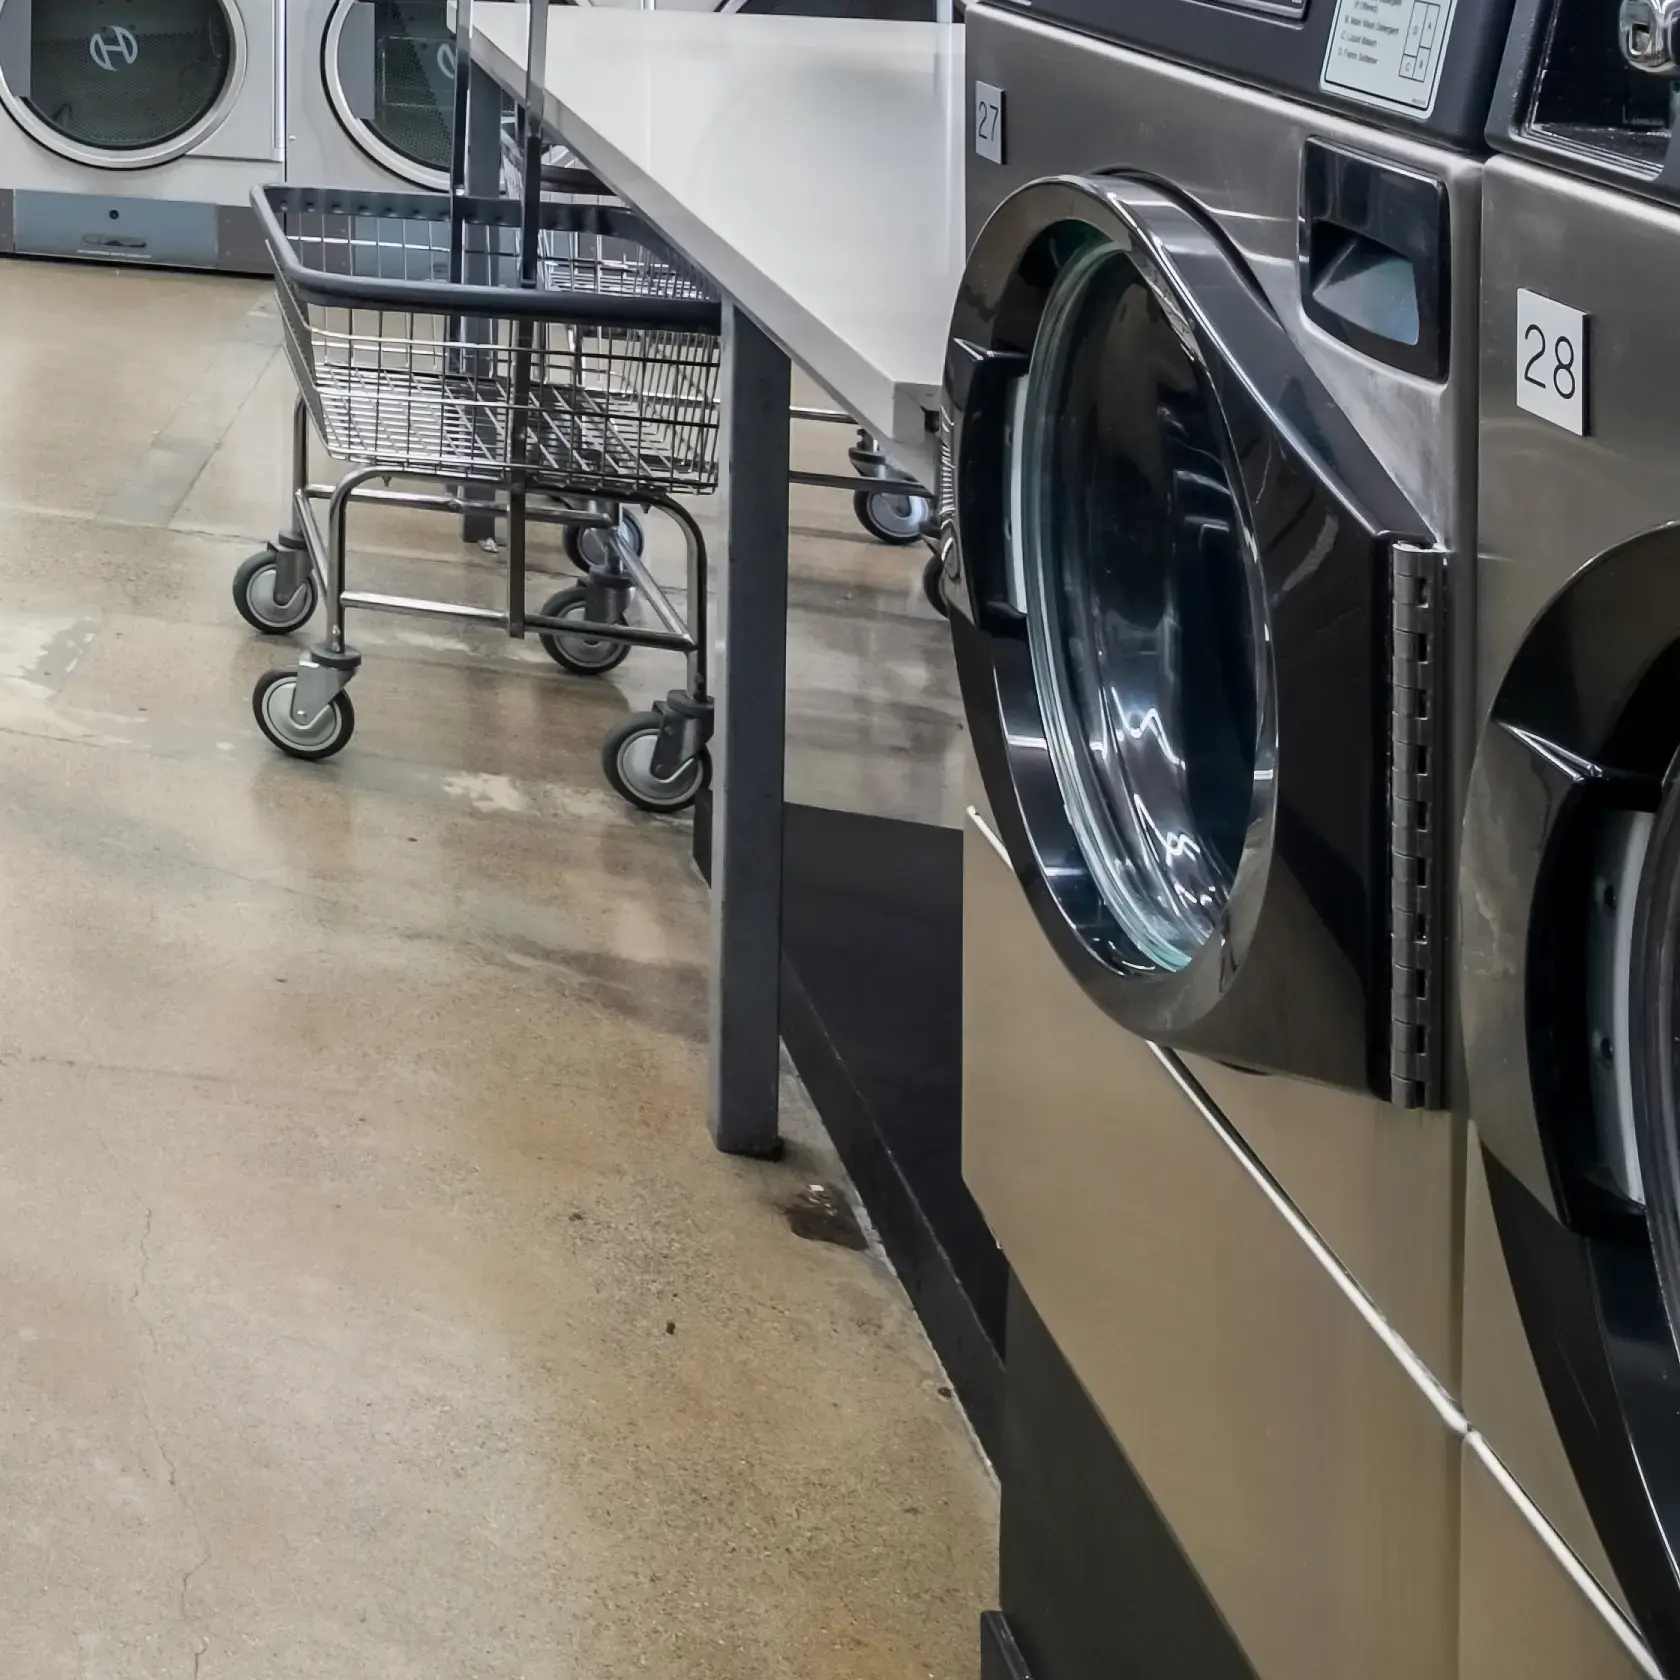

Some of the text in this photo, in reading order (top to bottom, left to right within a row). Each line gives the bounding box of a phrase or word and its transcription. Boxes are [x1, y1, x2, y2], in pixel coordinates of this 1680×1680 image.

[1427, 22, 1433, 31] A
[977, 100, 1000, 143] 27
[1524, 323, 1576, 400] 28
